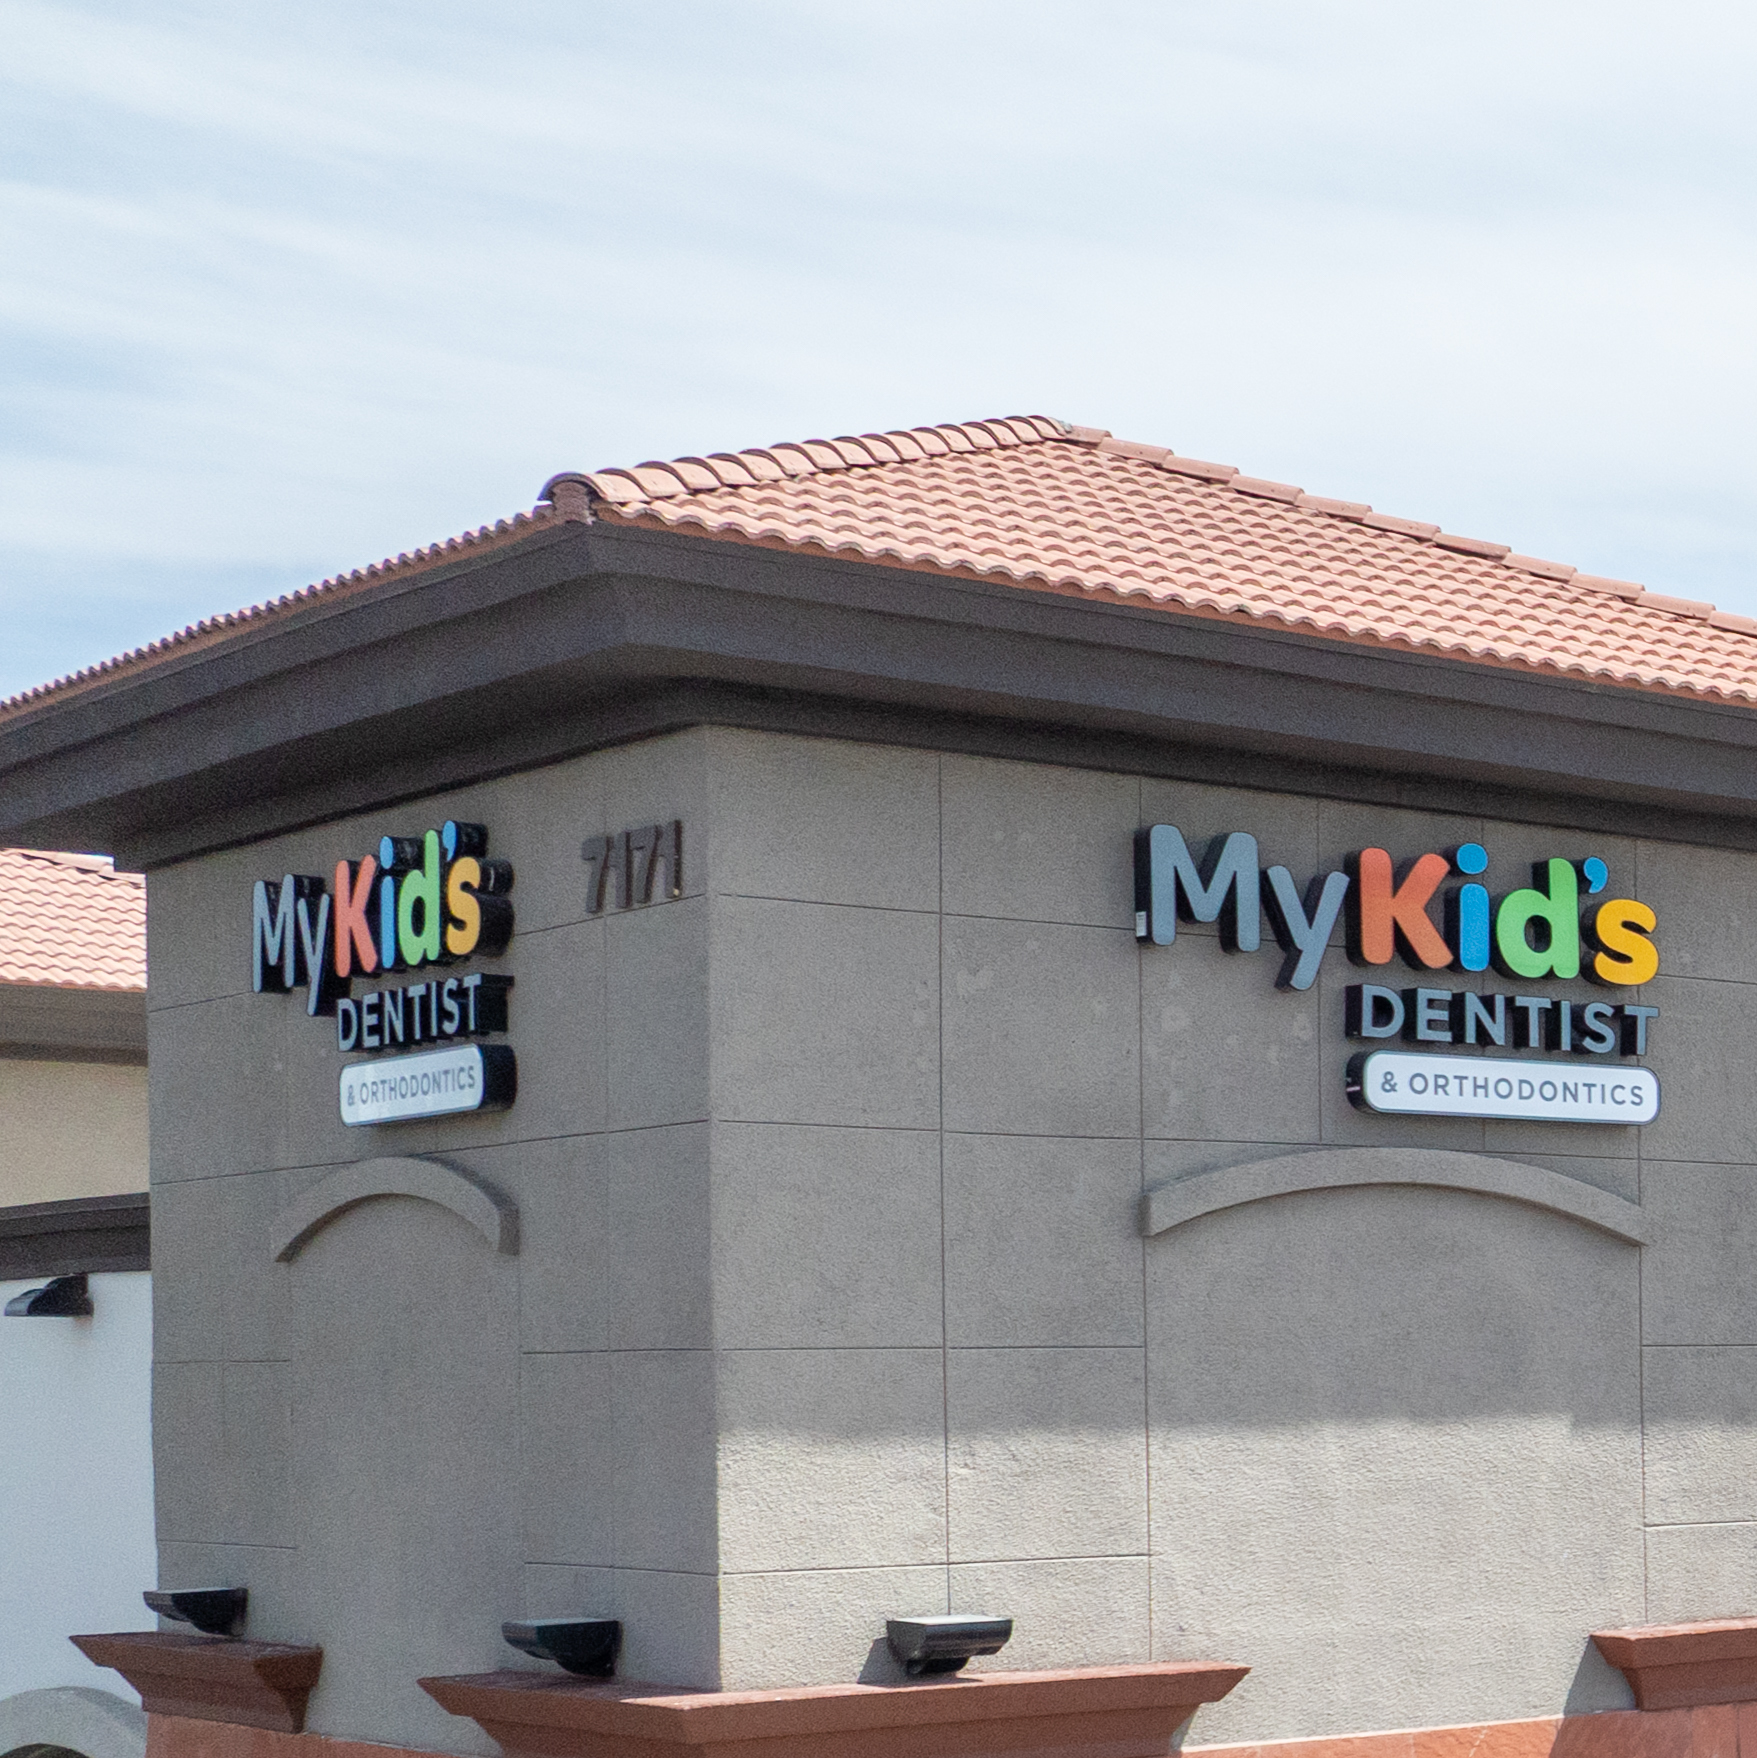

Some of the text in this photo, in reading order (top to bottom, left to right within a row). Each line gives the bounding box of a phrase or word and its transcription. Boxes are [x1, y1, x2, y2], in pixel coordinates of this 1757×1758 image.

[582, 819, 682, 913] 7171
[337, 973, 482, 1051] DENTIST
[1360, 984, 1660, 1056] DENTIST
[347, 1065, 476, 1106] & ORTHODONTICS
[1380, 1071, 1645, 1106] & ORTHODONTICS
